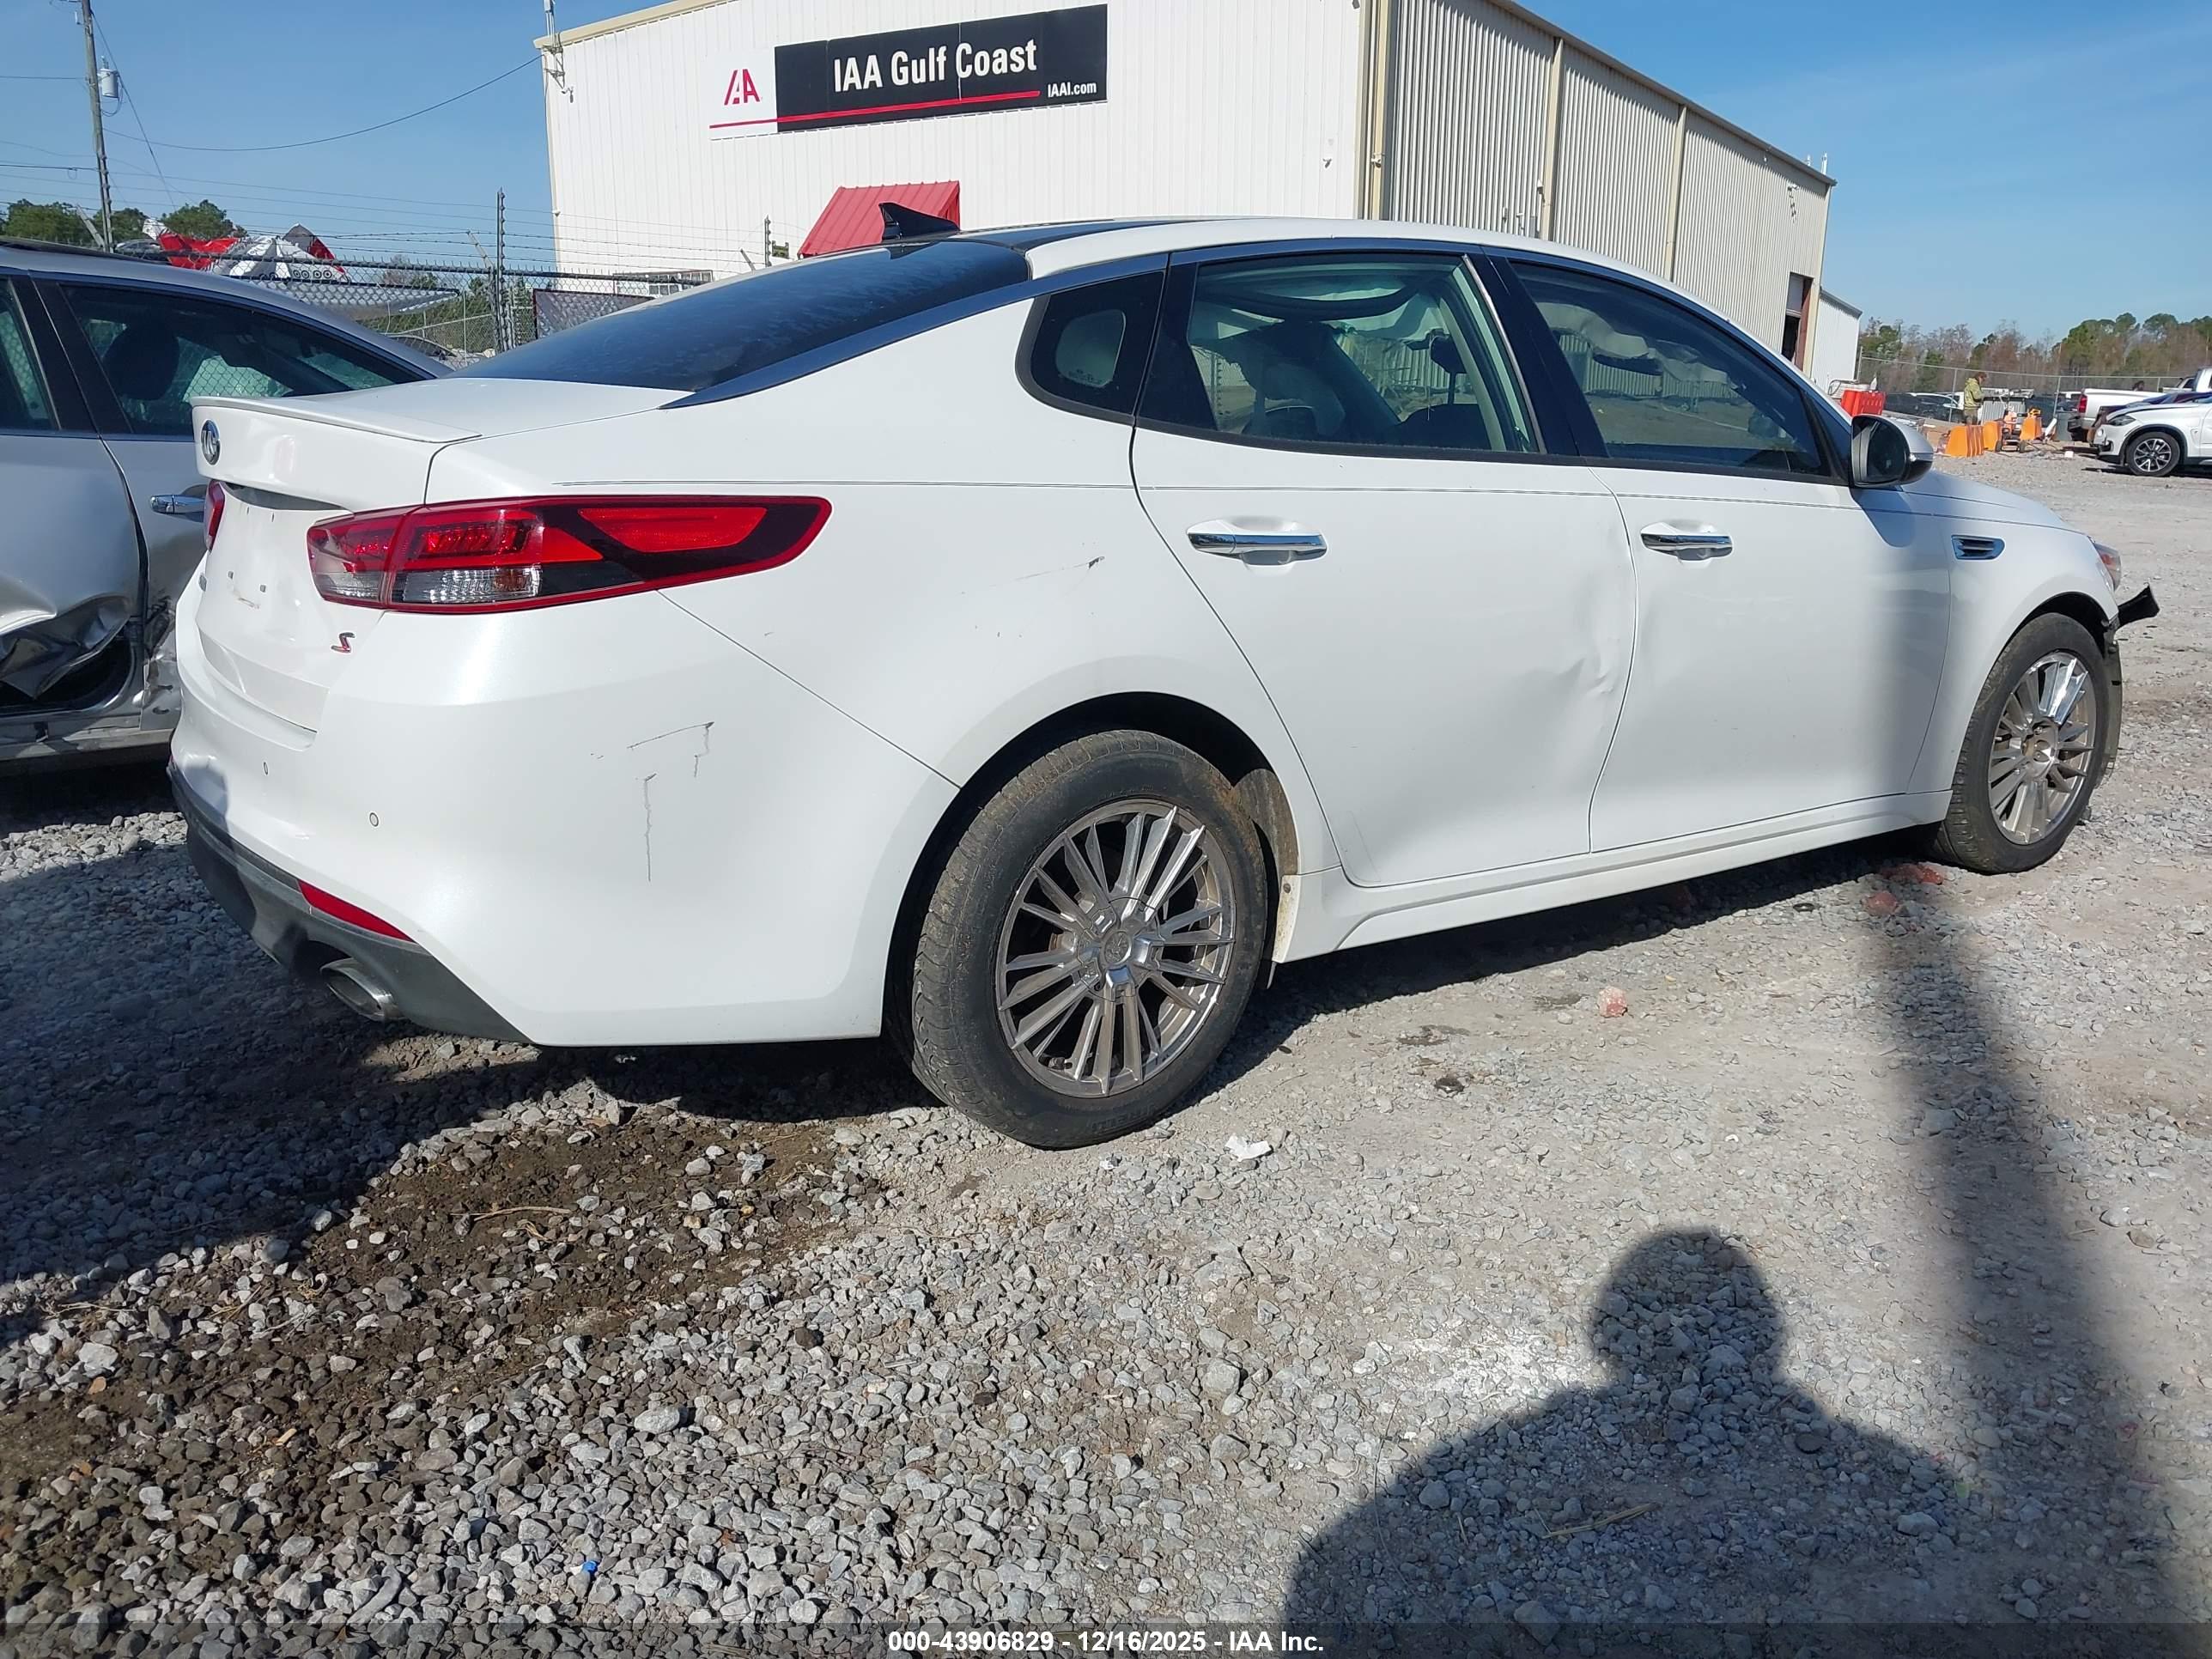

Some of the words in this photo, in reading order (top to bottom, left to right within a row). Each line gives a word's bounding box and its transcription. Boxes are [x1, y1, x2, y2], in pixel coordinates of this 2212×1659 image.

[834, 54, 883, 92] IAA
[890, 46, 946, 86] Gulf
[957, 39, 1037, 79] Coast
[1048, 82, 1097, 98] IAAI.com
[331, 632, 356, 653] S
